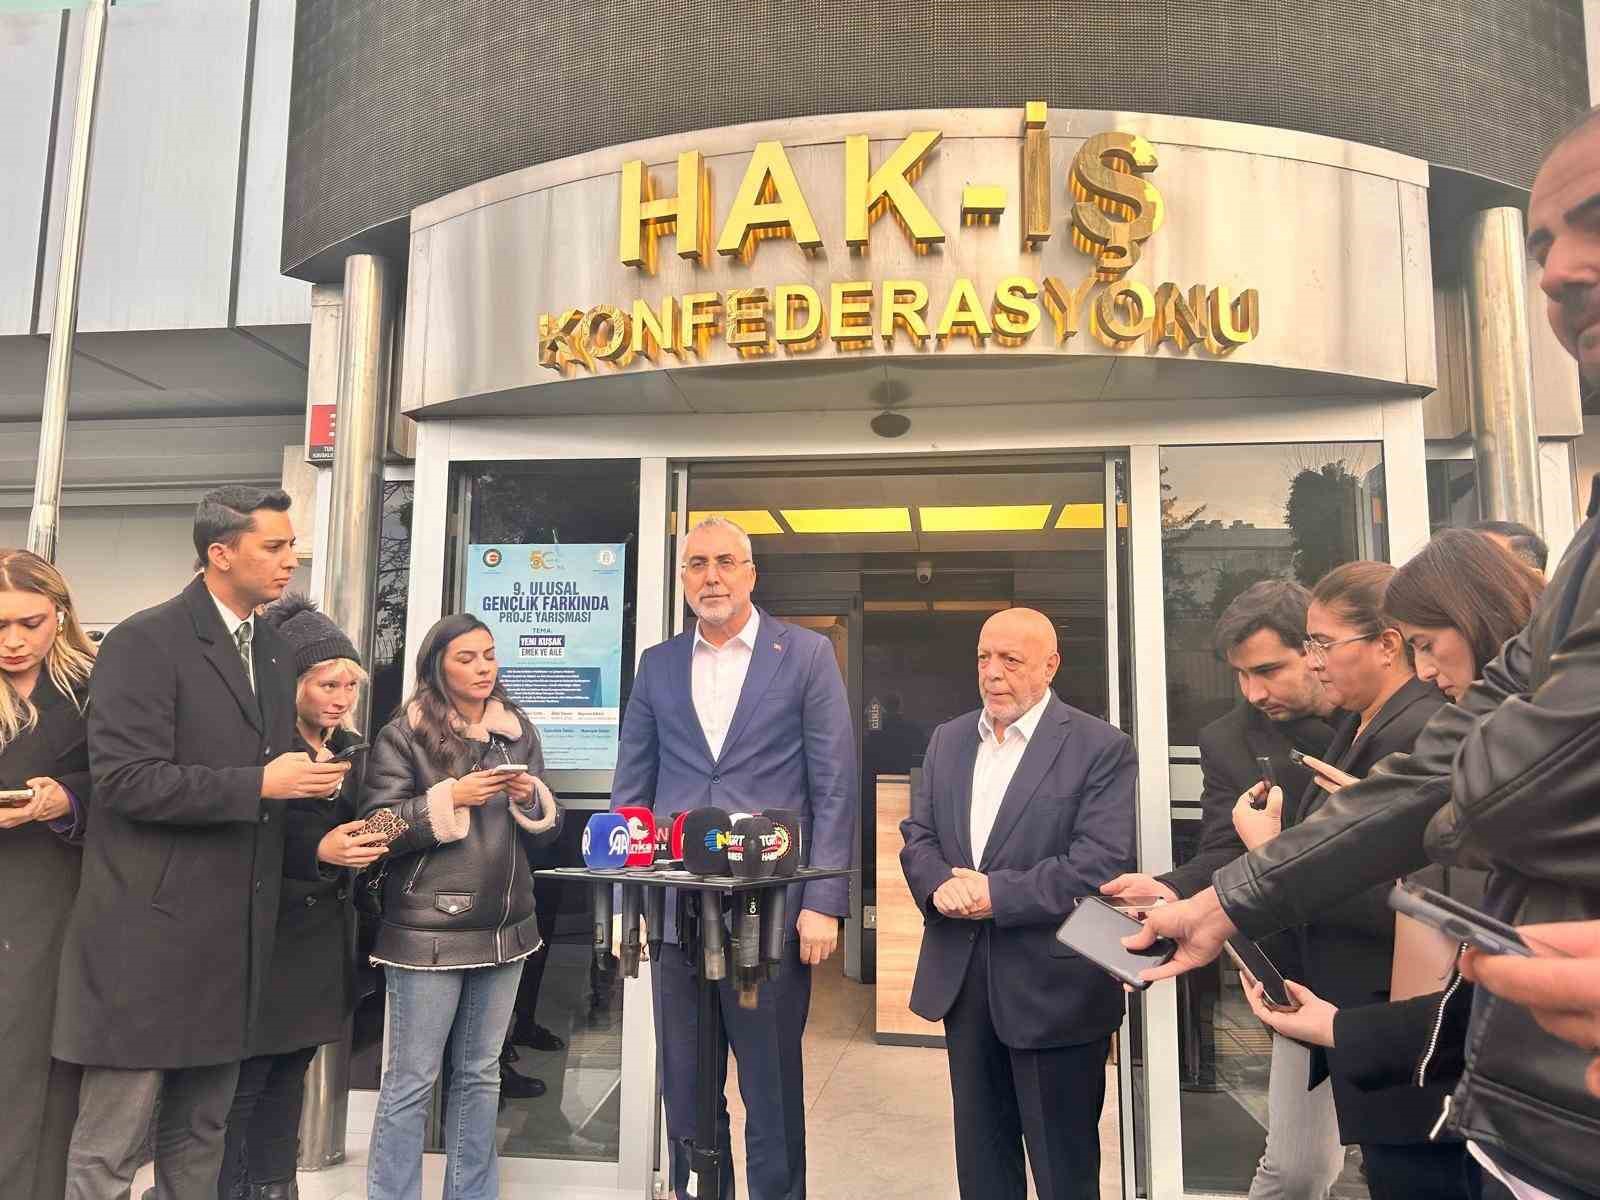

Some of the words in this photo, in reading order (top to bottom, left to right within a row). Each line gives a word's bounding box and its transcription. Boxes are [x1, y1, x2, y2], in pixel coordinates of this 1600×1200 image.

[619, 101, 1167, 274] HAK-İŞ
[538, 278, 1260, 371] KONFEDERASYONU
[513, 581, 525, 596] 9.
[529, 581, 580, 596] ULUSAL
[482, 595, 539, 613] GENÇLİK
[542, 595, 609, 611] FARKINDA
[499, 611, 532, 623] PROJE
[535, 611, 592, 624] YARIŞMASI
[538, 637, 563, 648] KUŞAK
[521, 647, 540, 656] EMEK
